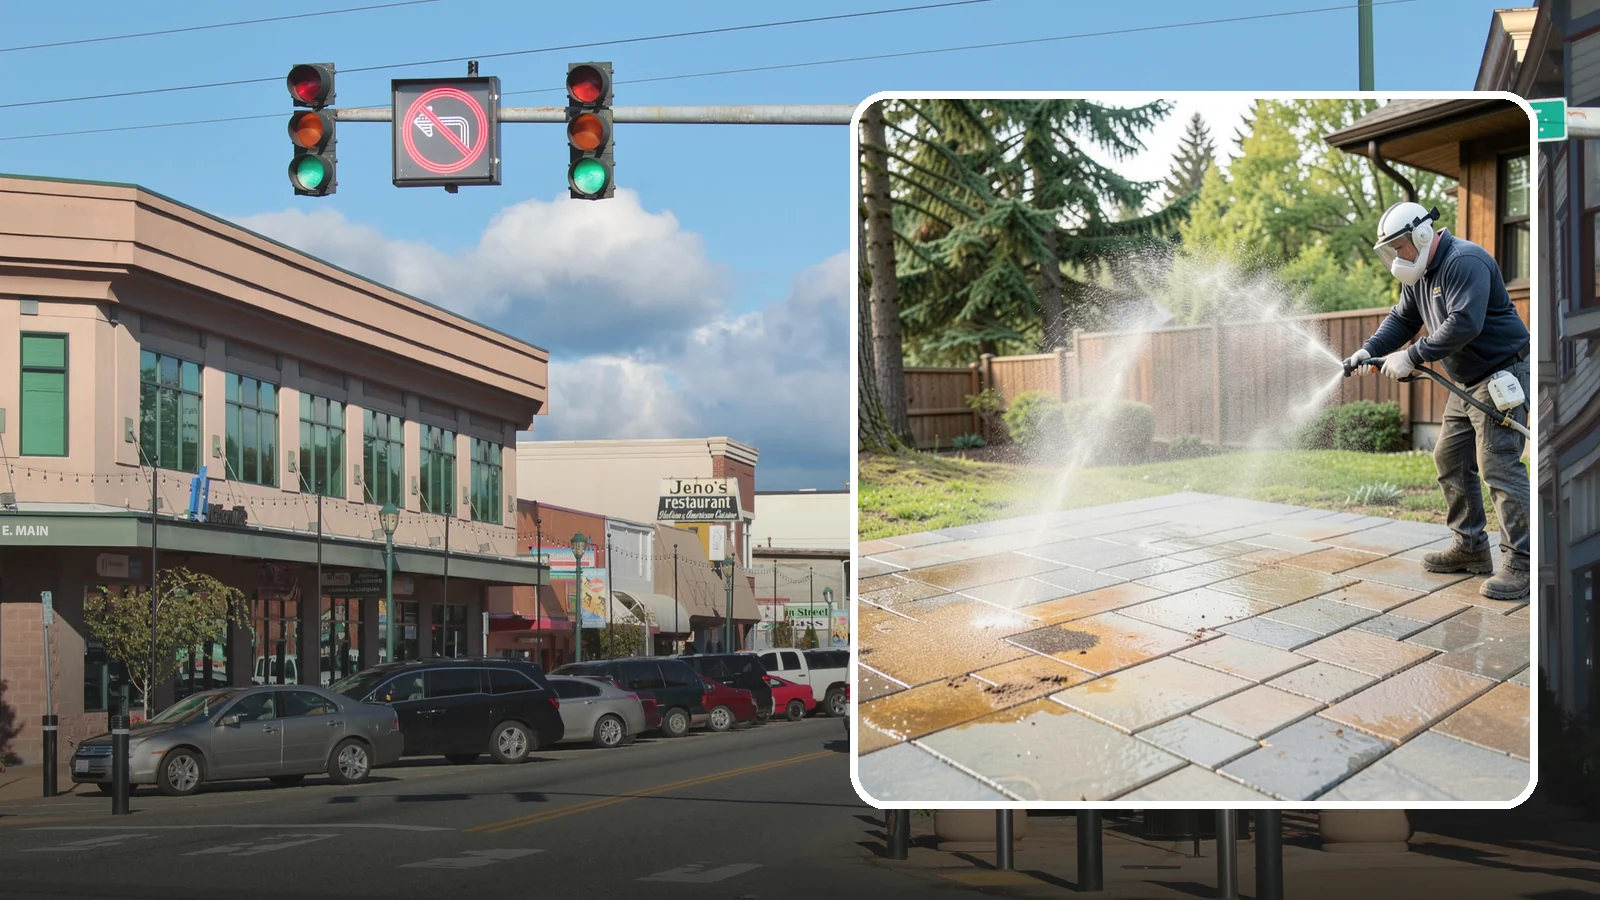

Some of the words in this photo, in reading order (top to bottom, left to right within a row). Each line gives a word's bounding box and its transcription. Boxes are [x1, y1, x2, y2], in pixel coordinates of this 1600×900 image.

[669, 479, 728, 495] Jeno's
[665, 496, 731, 509] restaurant
[658, 509, 681, 519] Italian
[685, 509, 715, 519] American
[714, 509, 738, 519] Cuisine
[2, 525, 13, 536] E.
[15, 525, 49, 536] MAIN
[797, 607, 828, 617] Street
